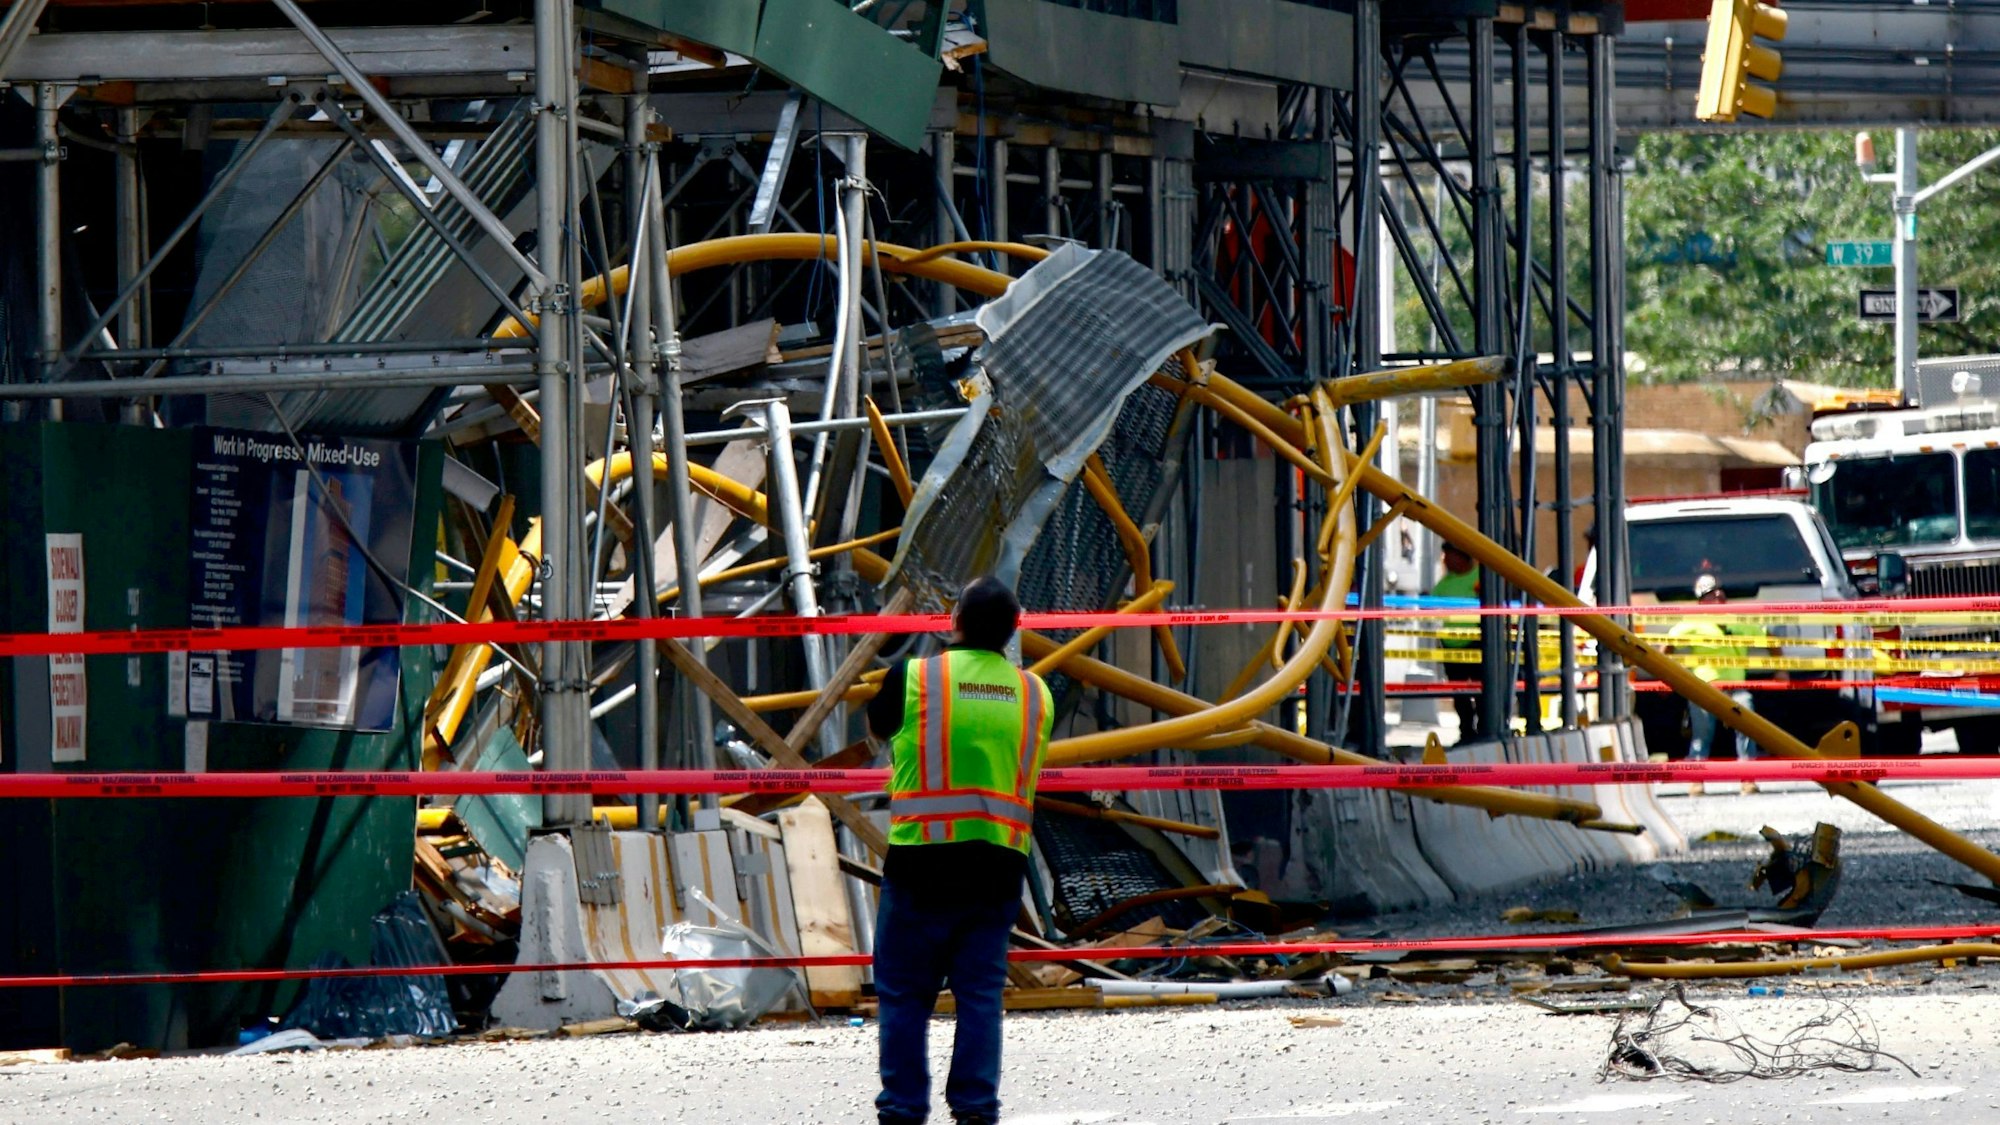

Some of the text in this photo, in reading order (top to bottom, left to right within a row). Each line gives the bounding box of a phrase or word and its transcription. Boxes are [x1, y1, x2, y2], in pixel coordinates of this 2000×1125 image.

[1832, 243, 1845, 264] W
[1853, 243, 1873, 264] 39
[213, 435, 236, 455] Work
[247, 438, 302, 463] Progress:
[308, 443, 380, 467] Mixed-Use
[56, 590, 78, 623] CLOSED
[958, 682, 1017, 696] MONADNOCK
[586, 773, 628, 781] MATERIAL
[750, 772, 800, 780] HAZARDOUS
